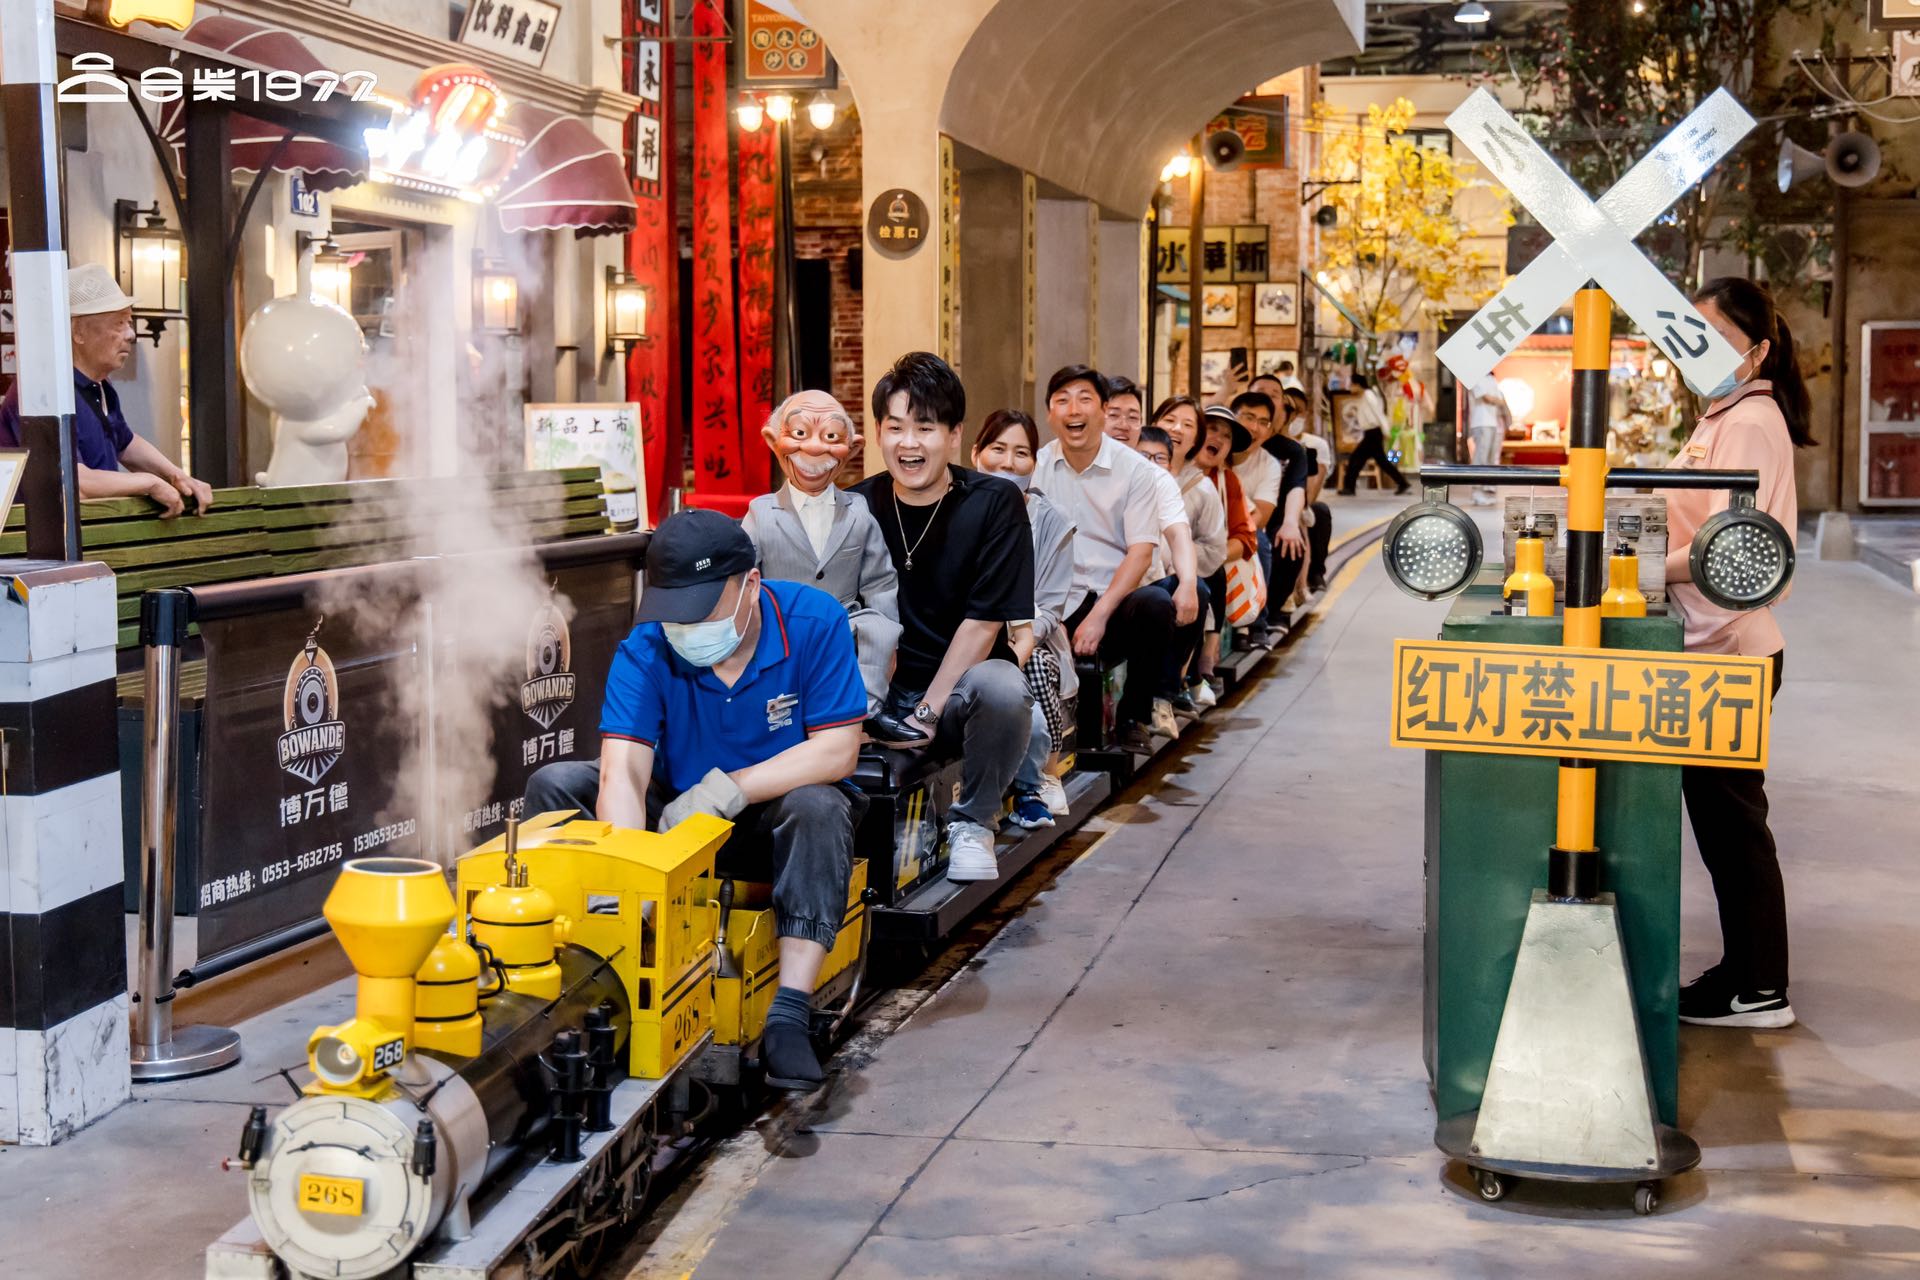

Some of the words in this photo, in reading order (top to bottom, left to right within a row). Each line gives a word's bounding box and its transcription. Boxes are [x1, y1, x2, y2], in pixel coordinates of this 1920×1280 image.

[536, 415, 628, 434] 新品上市
[523, 677, 574, 708] BOWANDE
[1405, 655, 1754, 752] 红灯禁止通行
[280, 723, 344, 763] BOWANDE
[522, 728, 575, 767] 博万德
[279, 781, 349, 828] 博万德
[261, 842, 343, 885] 0553-5632755
[353, 818, 416, 853] 15305532320
[673, 997, 701, 1051] 268
[374, 1040, 404, 1069] 268
[307, 1183, 355, 1208] 268
